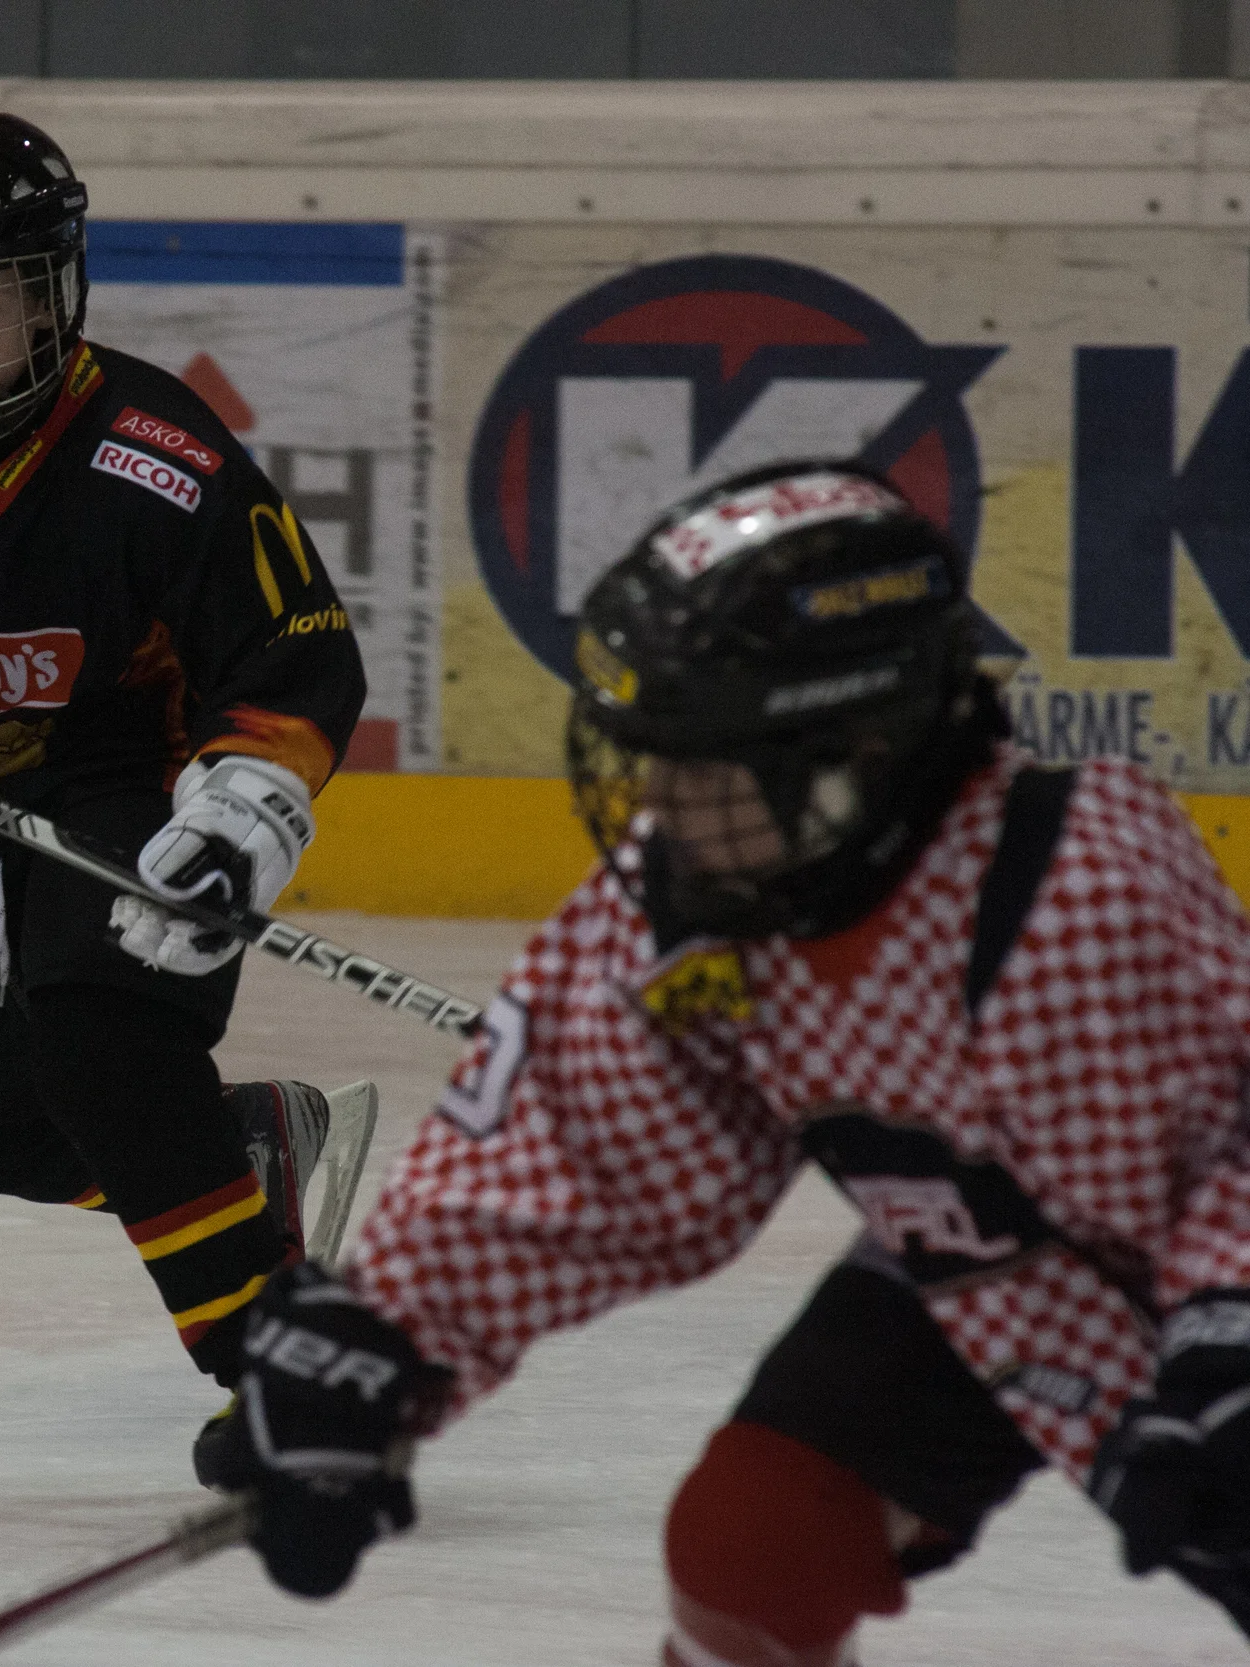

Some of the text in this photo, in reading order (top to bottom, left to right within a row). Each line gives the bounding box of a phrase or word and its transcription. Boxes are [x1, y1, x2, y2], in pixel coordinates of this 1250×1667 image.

[120, 415, 187, 448] ASKÖ
[98, 445, 199, 506] RICOH
[999, 672, 1187, 776] ÄRME-,
[257, 921, 482, 1030] FISCHER
